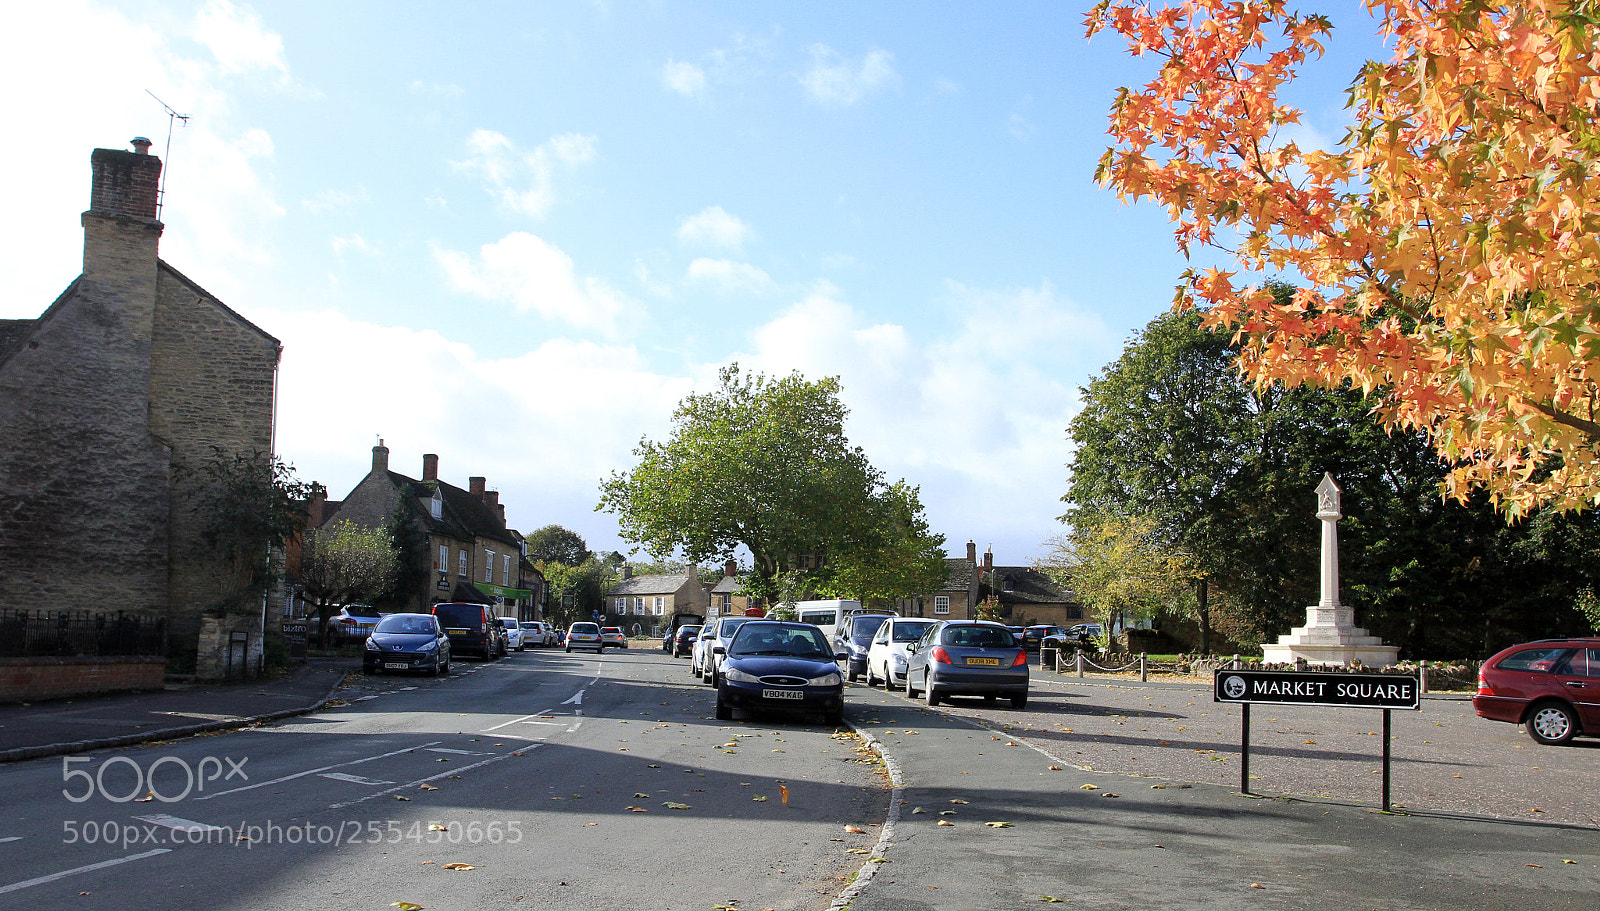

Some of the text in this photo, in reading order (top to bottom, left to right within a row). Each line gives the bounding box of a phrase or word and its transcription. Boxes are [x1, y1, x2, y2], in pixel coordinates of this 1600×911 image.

[764, 690, 803, 699] V804 KAG
[1253, 680, 1411, 699] MARKET SQUARE
